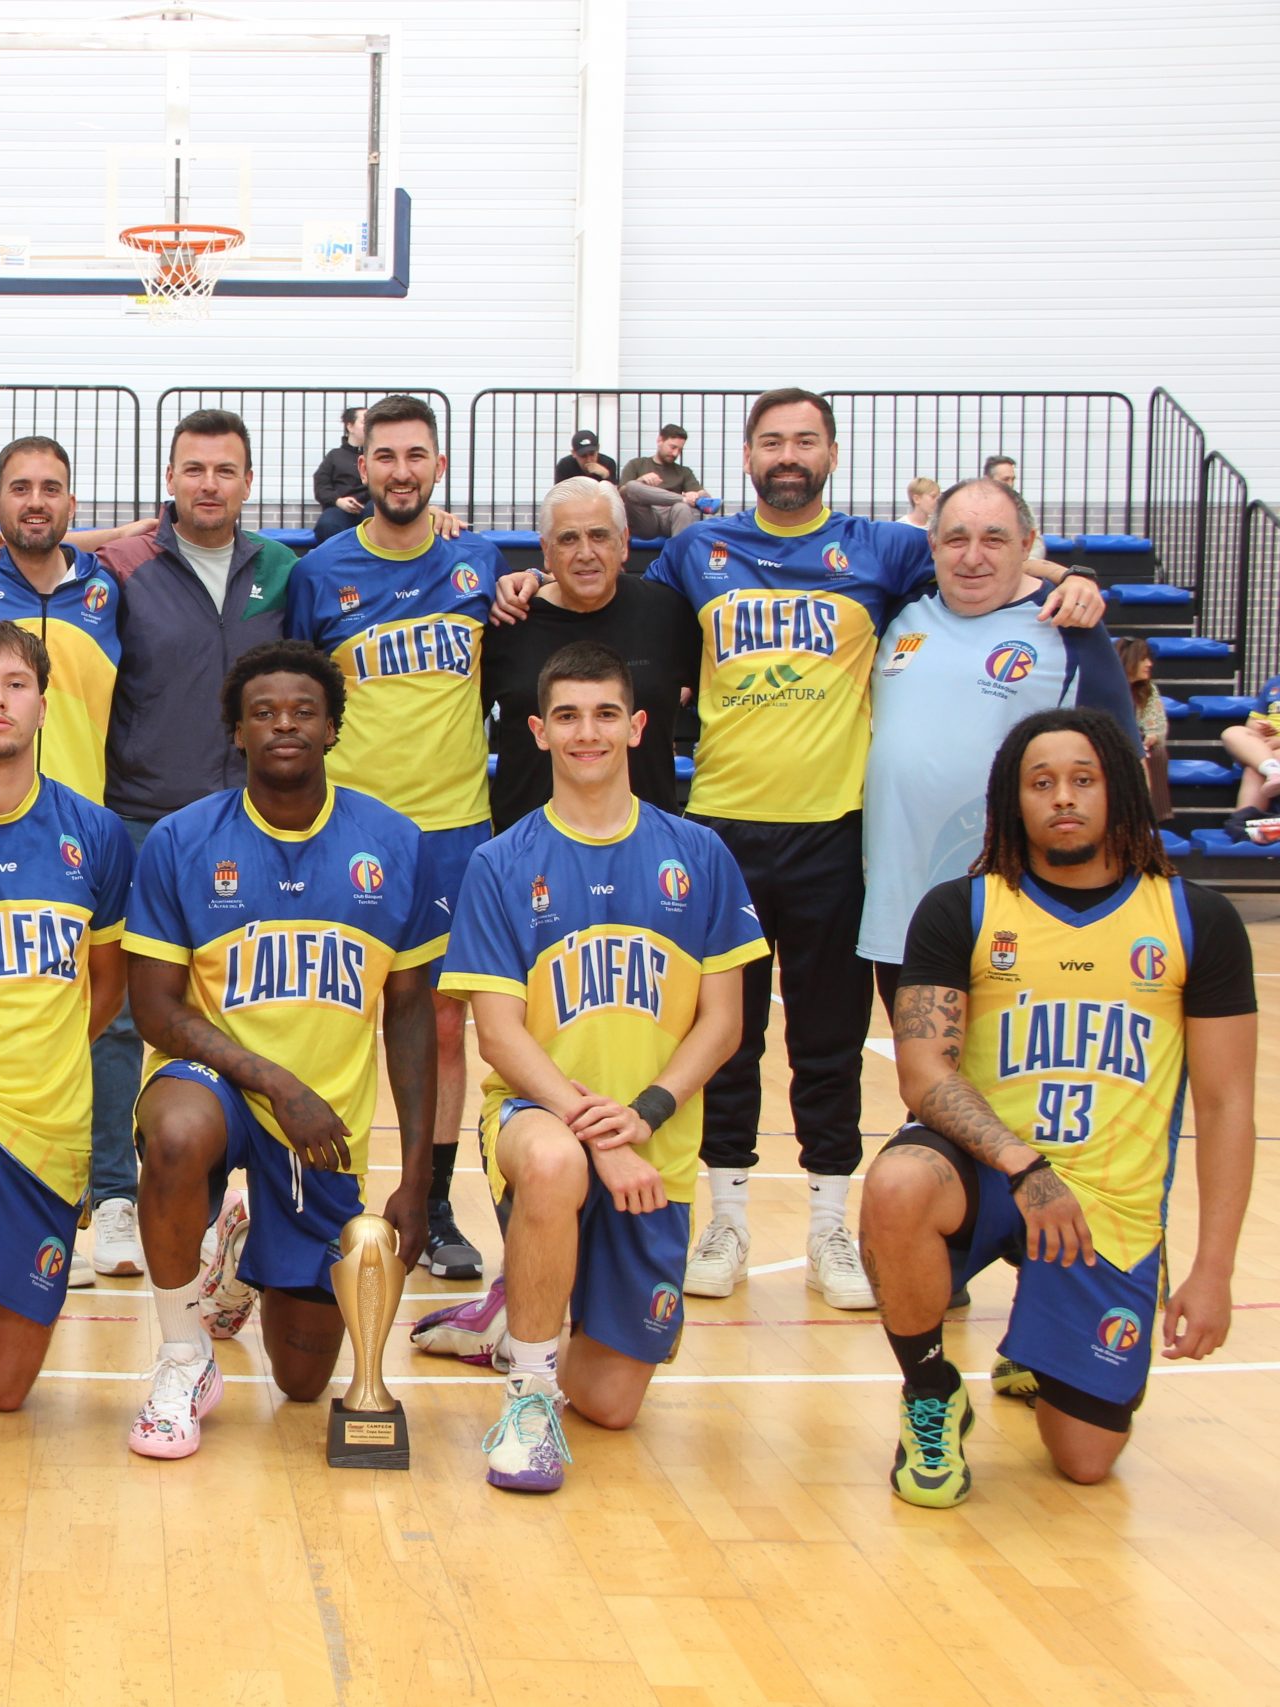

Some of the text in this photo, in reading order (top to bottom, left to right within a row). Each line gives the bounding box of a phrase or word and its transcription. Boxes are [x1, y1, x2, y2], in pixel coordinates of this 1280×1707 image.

[395, 588, 420, 599] vive
[278, 880, 305, 892] vive
[589, 883, 615, 895] vive
[1059, 959, 1094, 971] vive
[1034, 1080, 1096, 1145] 93
